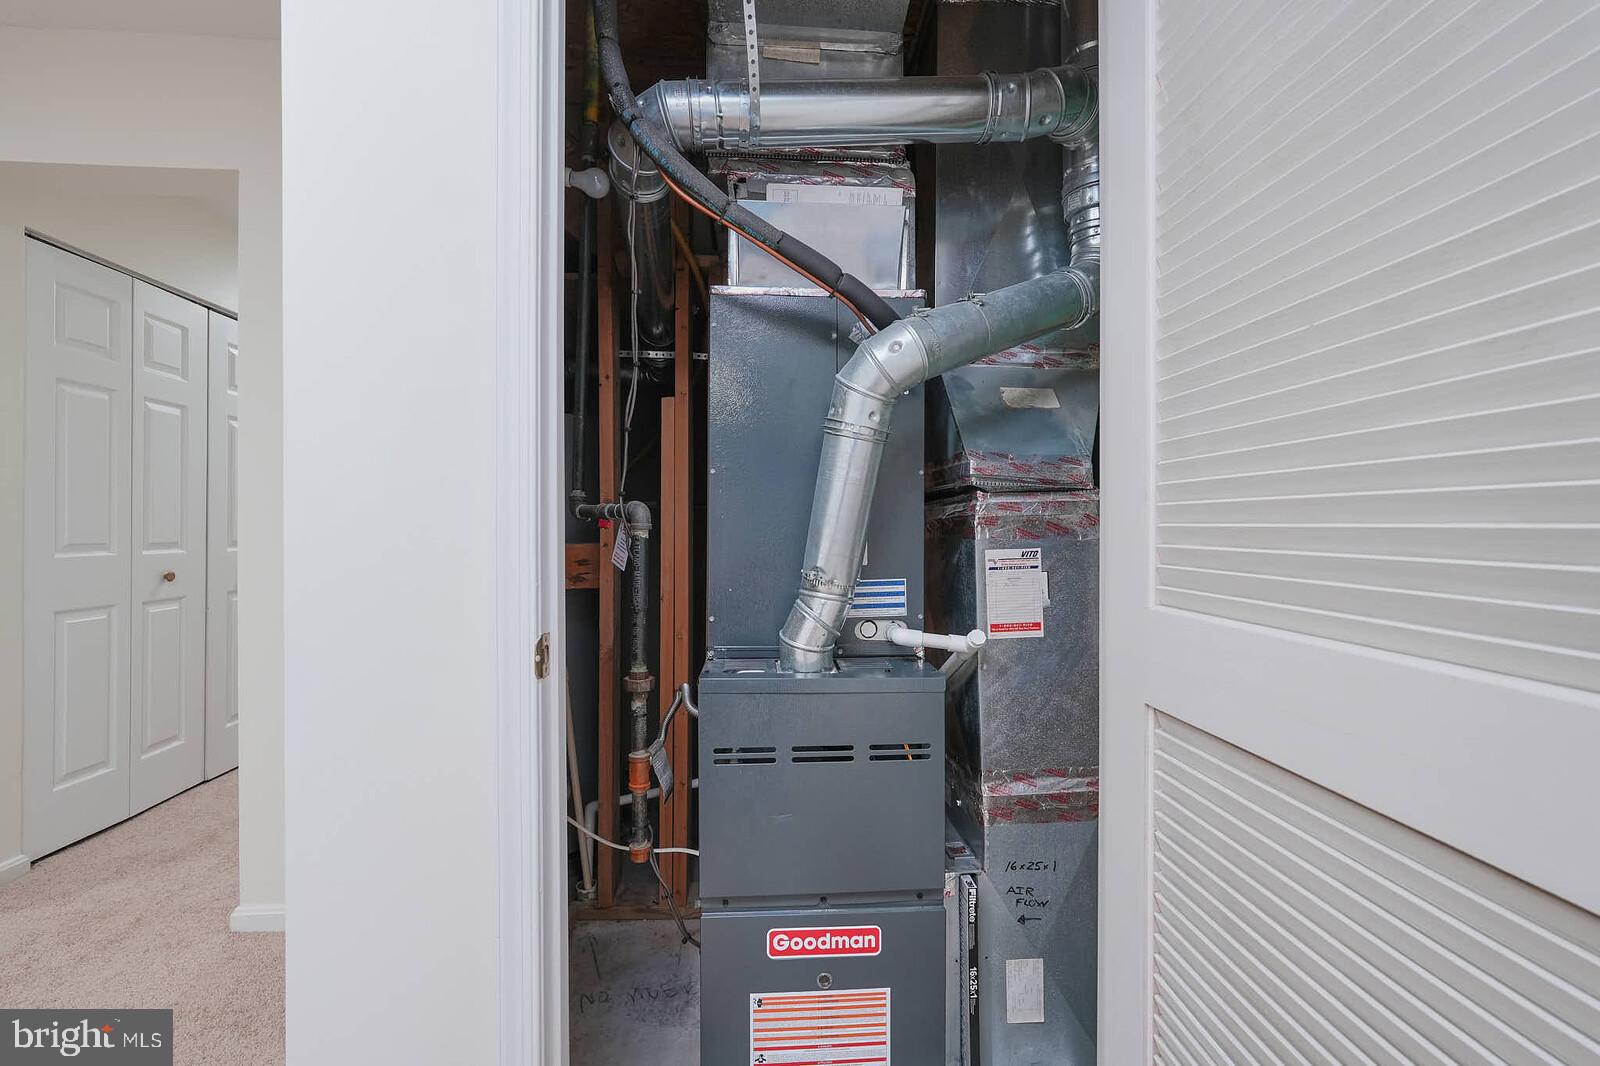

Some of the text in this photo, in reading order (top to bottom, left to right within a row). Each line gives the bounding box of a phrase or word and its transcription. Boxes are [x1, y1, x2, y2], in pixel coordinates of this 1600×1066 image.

[1021, 550, 1039, 558] VITO
[1005, 886, 1034, 897] AIR
[968, 888, 977, 923] Filtrete
[1015, 898, 1050, 908] FLOW
[772, 932, 876, 951] Goodman
[969, 966, 978, 999] 16x25x1
